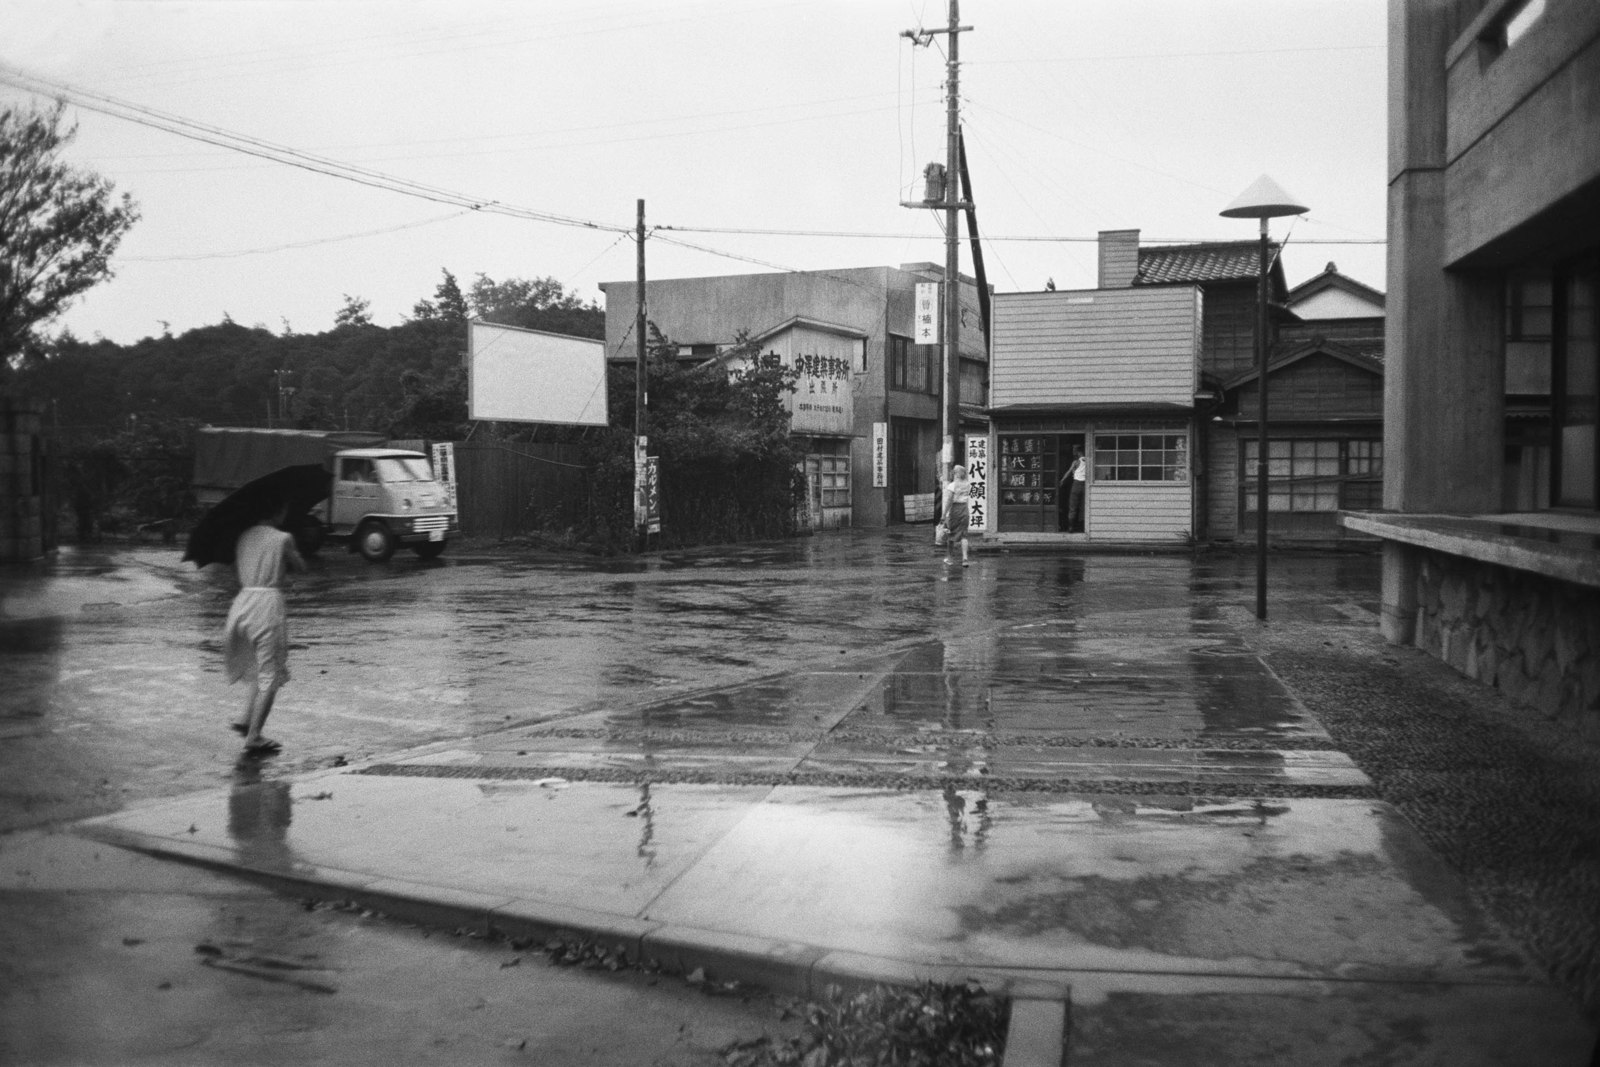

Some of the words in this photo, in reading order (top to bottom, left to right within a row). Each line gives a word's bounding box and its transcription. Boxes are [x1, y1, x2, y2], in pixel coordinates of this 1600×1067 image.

[969, 440, 978, 459] 工場
[978, 440, 986, 459] 建築
[647, 463, 657, 511] カルメン
